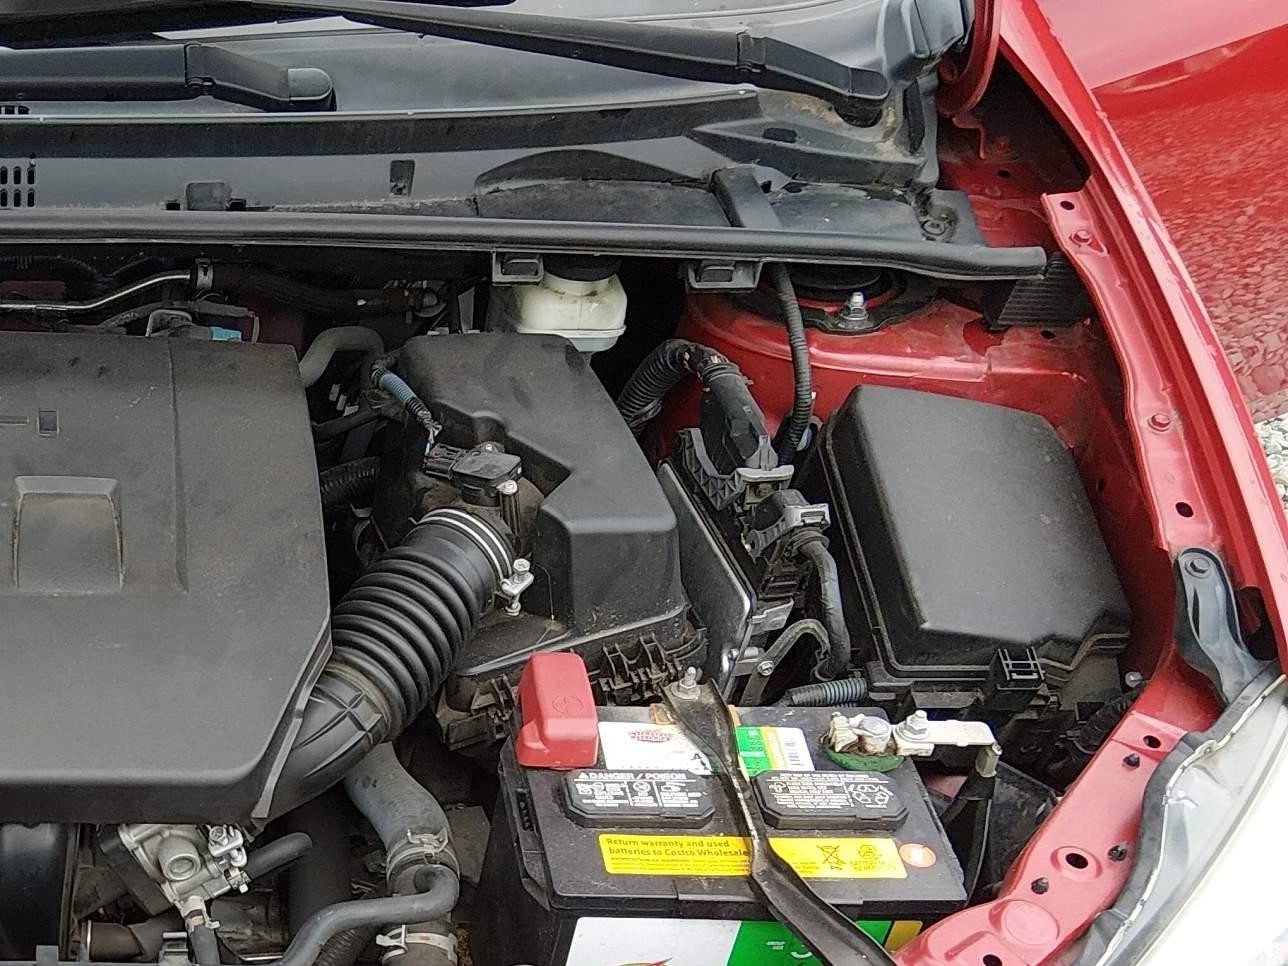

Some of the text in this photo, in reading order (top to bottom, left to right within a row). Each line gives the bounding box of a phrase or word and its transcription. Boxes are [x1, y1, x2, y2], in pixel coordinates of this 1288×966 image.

[607, 838, 639, 846] Return
[641, 840, 684, 848] warranty
[707, 840, 730, 848] used
[609, 848, 651, 856] batteries
[699, 849, 751, 857] Wholesale
